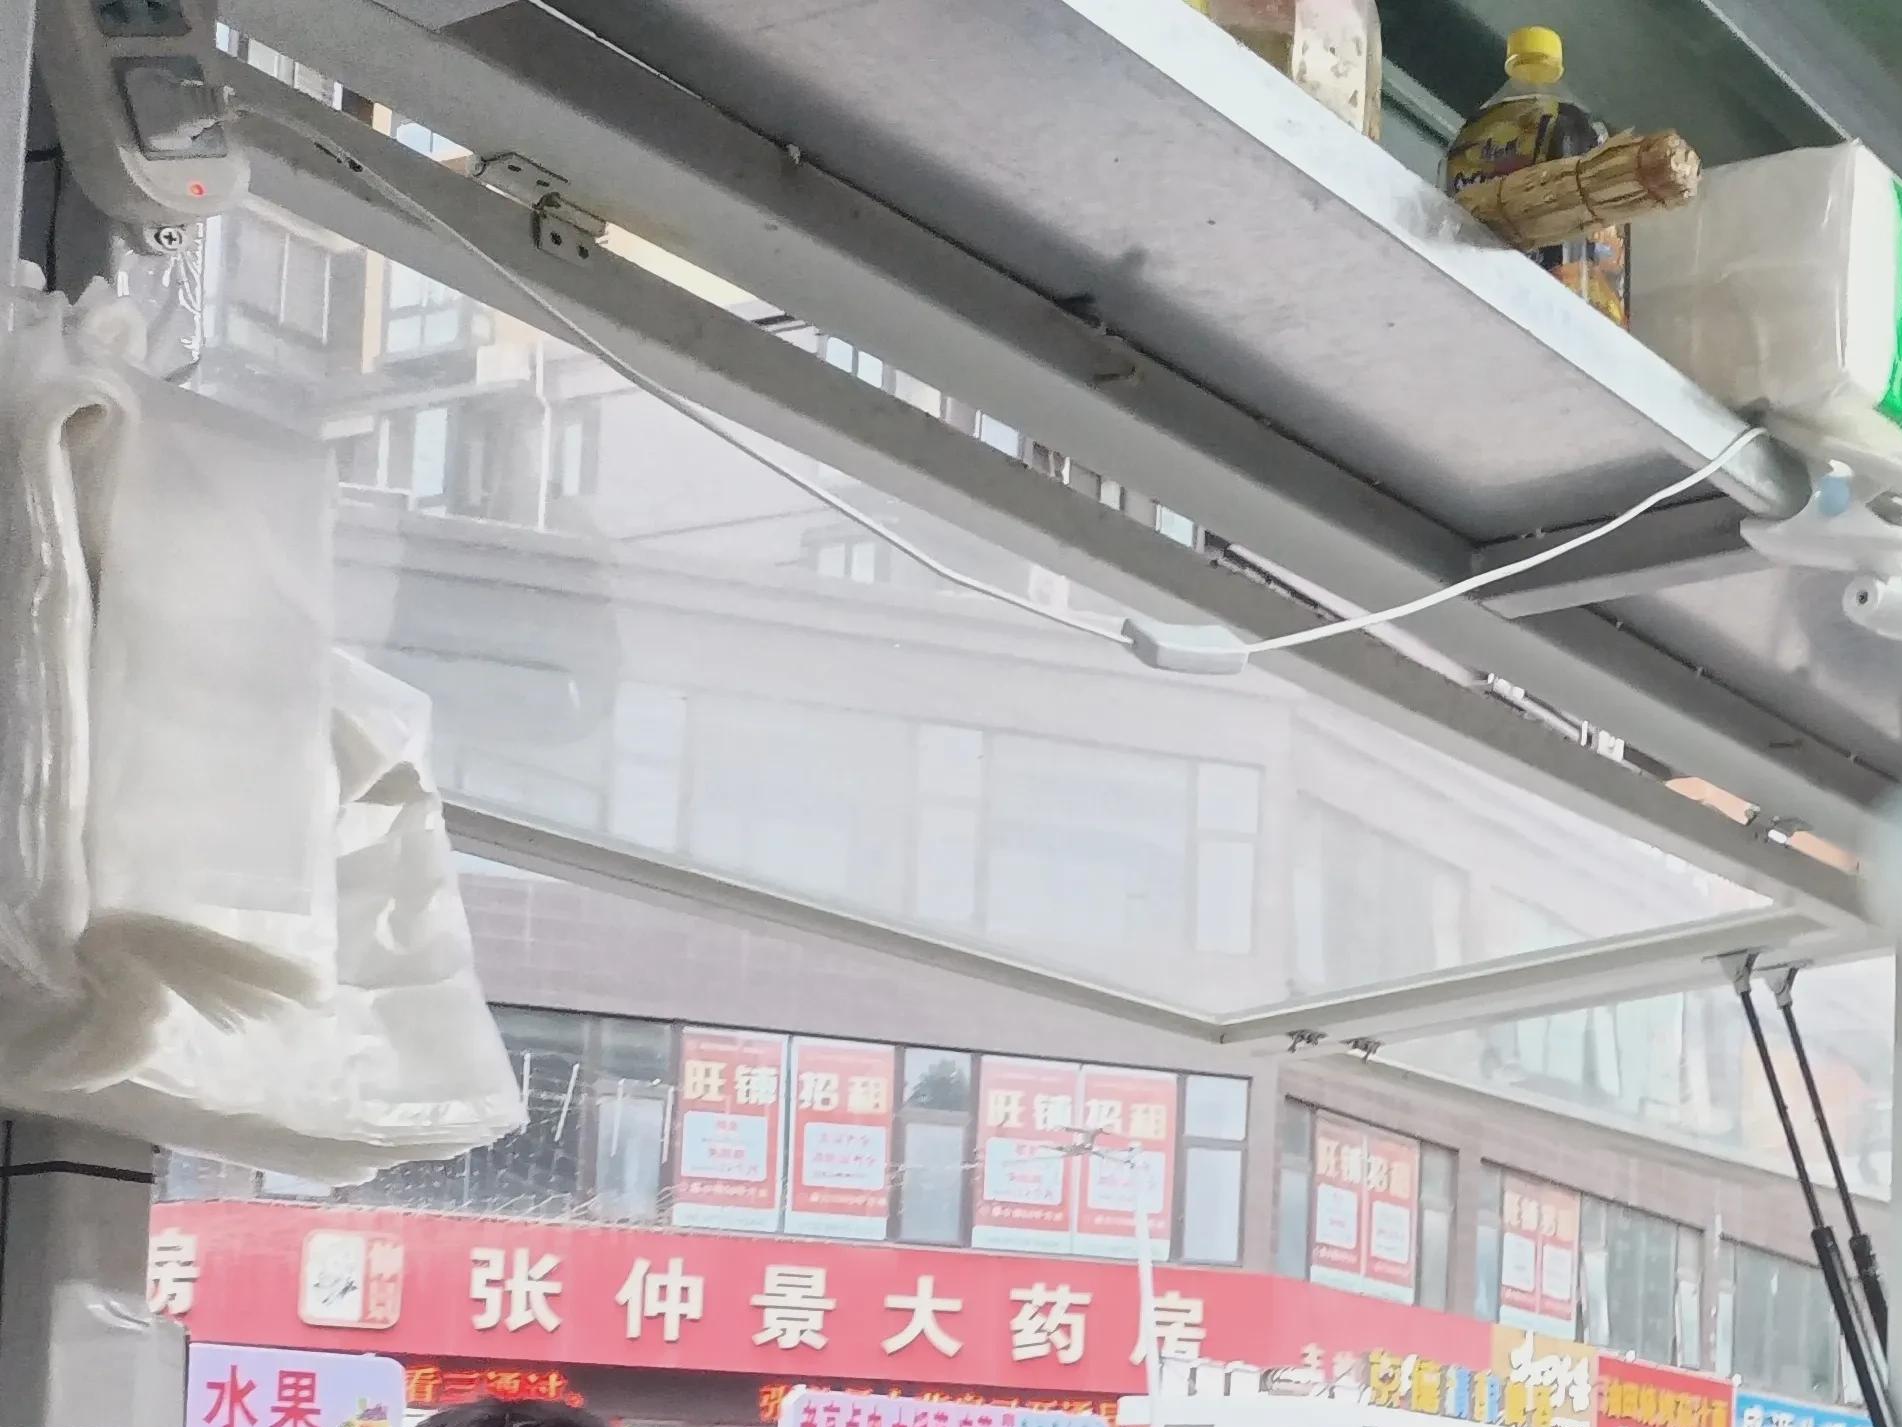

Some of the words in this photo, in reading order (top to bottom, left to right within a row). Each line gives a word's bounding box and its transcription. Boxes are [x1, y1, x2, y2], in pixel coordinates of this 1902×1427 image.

[469, 1246, 1208, 1367] 张仲景大药房
